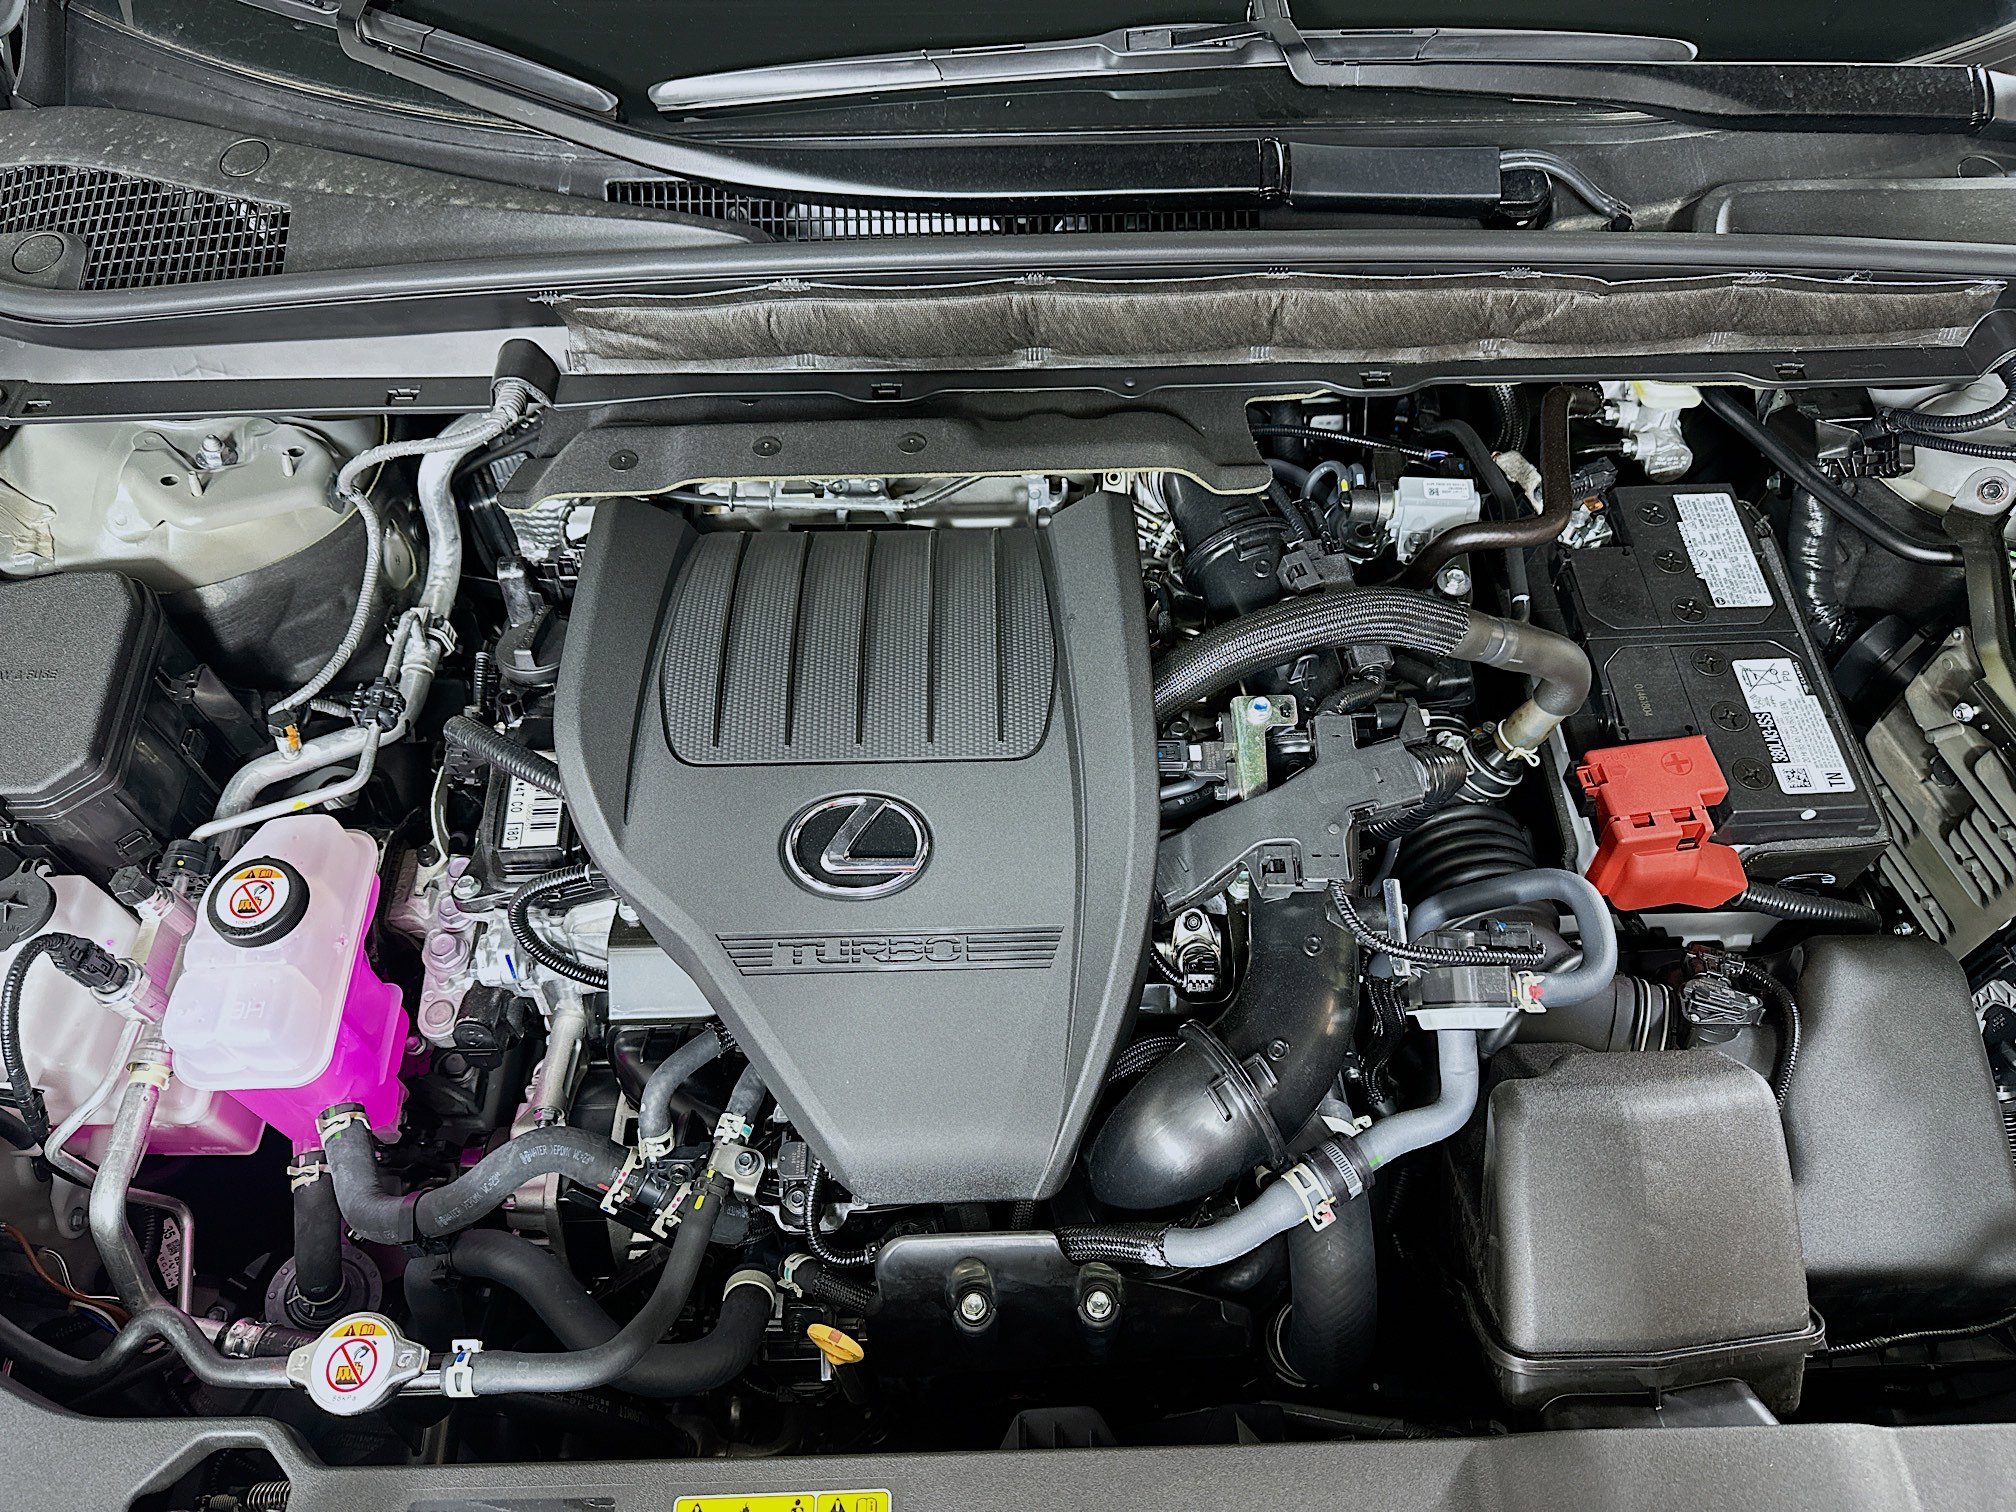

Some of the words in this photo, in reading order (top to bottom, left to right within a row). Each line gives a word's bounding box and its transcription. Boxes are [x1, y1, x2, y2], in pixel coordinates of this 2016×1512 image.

[1782, 671, 1792, 682] Pb
[1755, 712, 1790, 763] 380LN3-ISS
[1824, 772, 1846, 787] TN
[777, 936, 961, 964] TURBO
